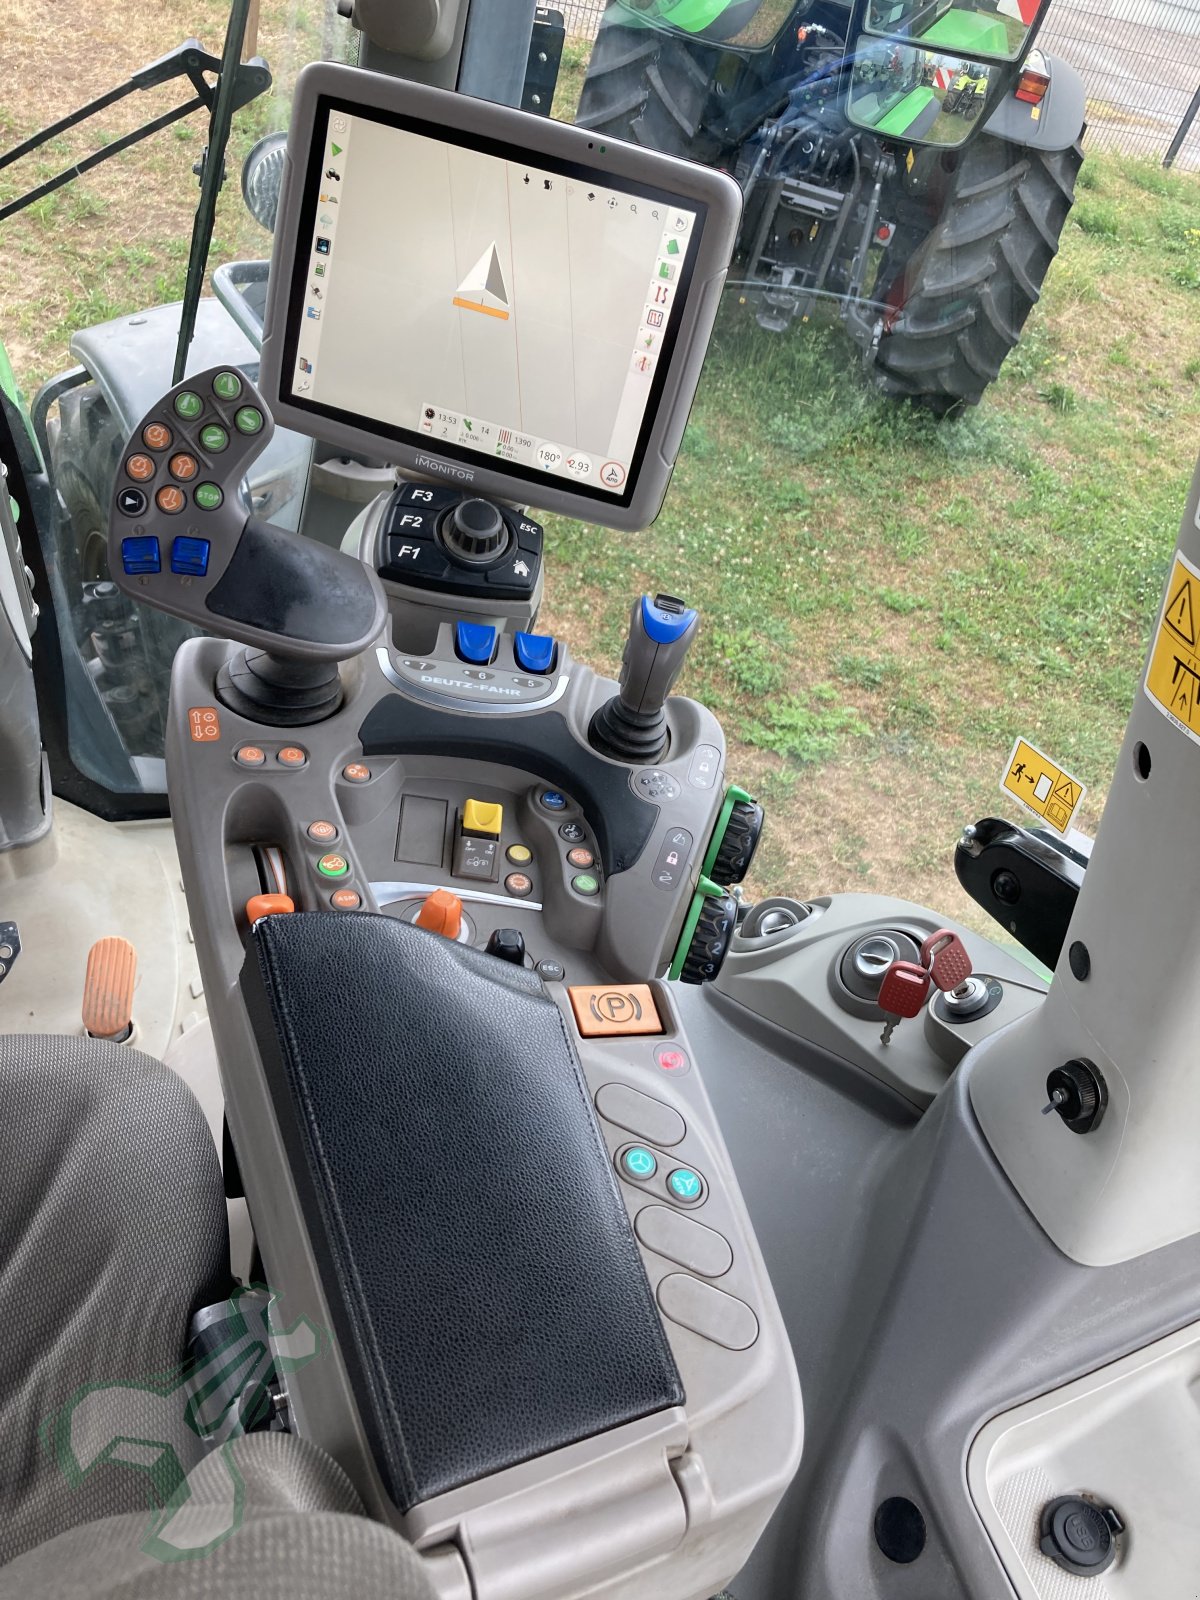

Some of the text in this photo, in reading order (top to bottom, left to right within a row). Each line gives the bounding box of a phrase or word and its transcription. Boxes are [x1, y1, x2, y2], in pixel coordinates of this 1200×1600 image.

[439, 413, 457, 425] 13:53
[481, 426, 490, 435] 14
[514, 436, 532, 448] 1390
[568, 459, 590, 473] 2.93
[196, 491, 219, 501] STOP
[411, 489, 434, 502] F3
[399, 514, 423, 528] F2
[519, 523, 538, 535] ESC
[397, 545, 421, 560] F1
[419, 662, 426, 670] 7
[478, 672, 486, 680] 6
[420, 675, 521, 697] DEUTZ-FAHR
[527, 680, 535, 688] 5
[744, 835, 752, 847] 3
[736, 857, 745, 867] 4
[337, 893, 356, 903] ASM
[725, 900, 733, 911] 0
[721, 920, 729, 932] 1
[711, 941, 722, 955] 2
[542, 963, 560, 973] ESC
[704, 963, 715, 974] 3
[606, 996, 625, 1018] P
